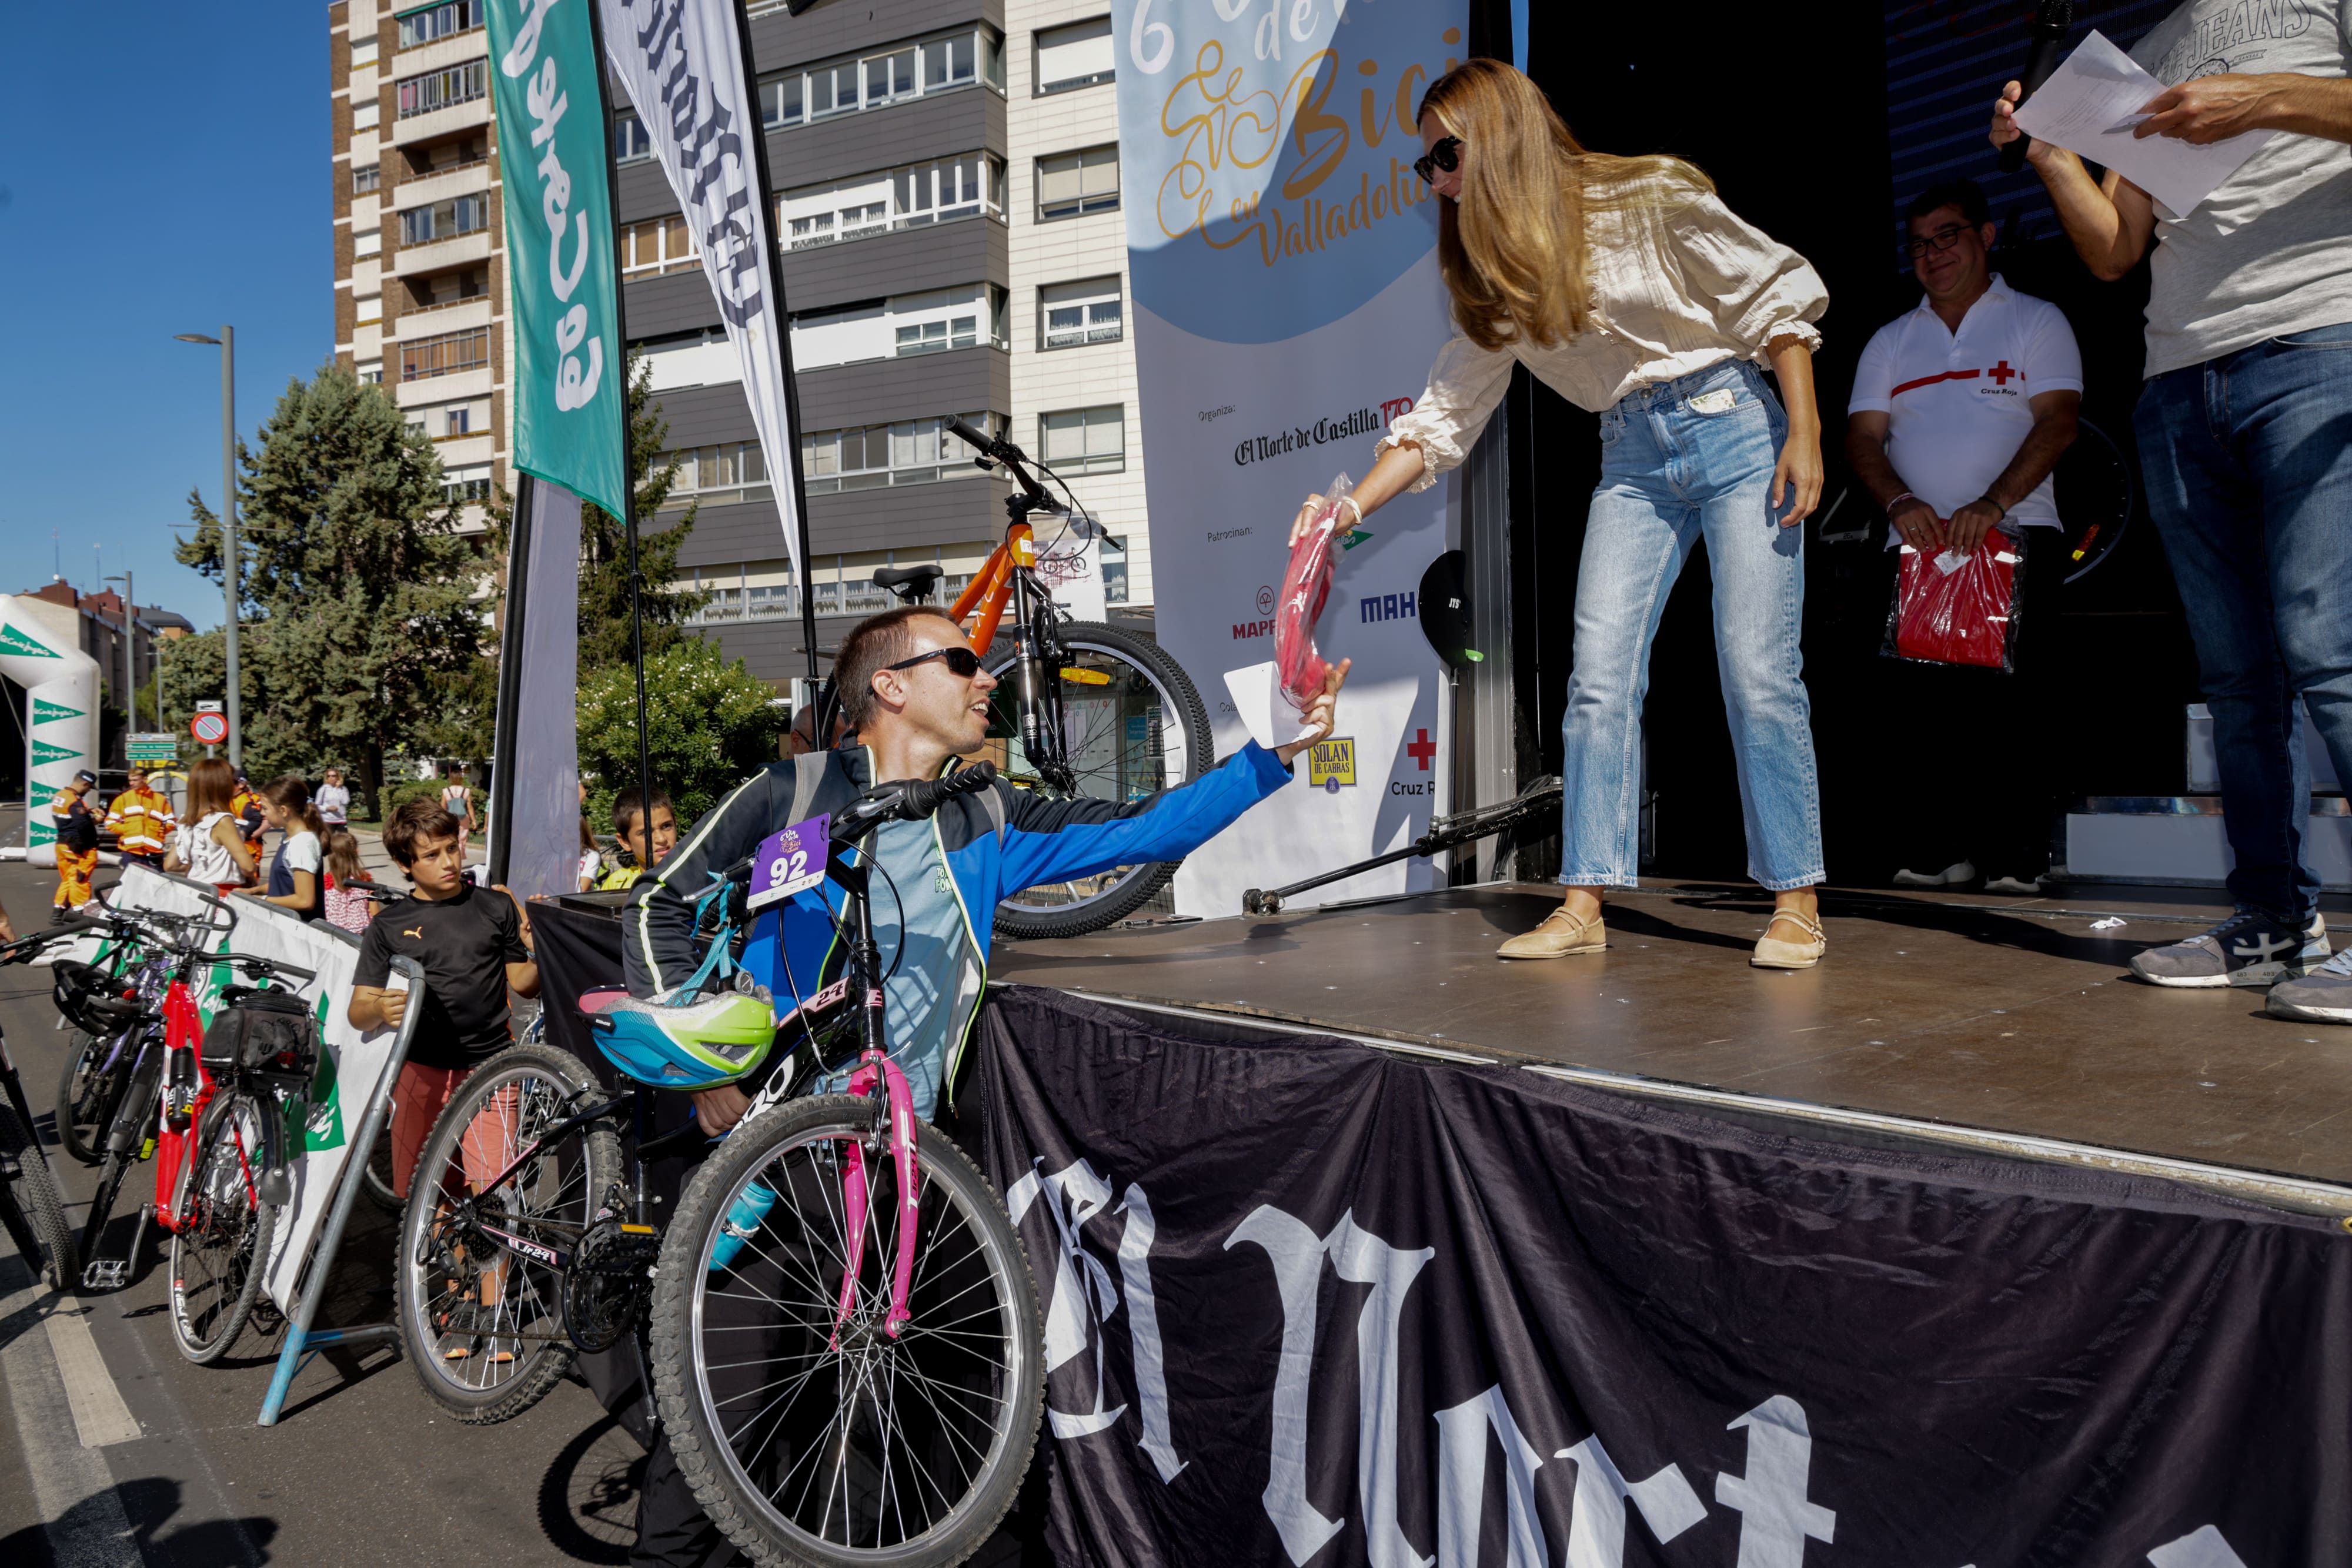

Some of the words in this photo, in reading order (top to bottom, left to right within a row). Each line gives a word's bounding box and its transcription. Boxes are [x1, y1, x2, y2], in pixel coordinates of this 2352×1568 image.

[2187, 0, 2311, 69] JEANS
[2238, 53, 2259, 61] KANSAS
[1230, 190, 1258, 223] en
[2002, 388, 2018, 396] Roja
[1198, 404, 1236, 422] Organiza:
[1235, 439, 1255, 466] El
[1255, 430, 1294, 462] Norte
[1295, 427, 1310, 450] de
[1313, 407, 1380, 444] Castilla
[1207, 526, 1253, 543] Patrocinan:
[1361, 591, 1416, 623] MAH
[1314, 763, 1322, 774] DE
[1324, 763, 1349, 774] CABRAS
[1391, 781, 1424, 795] Cruz
[770, 850, 808, 888] 92
[816, 982, 843, 1007] 24
[1223, 1204, 1836, 1568] Nort
